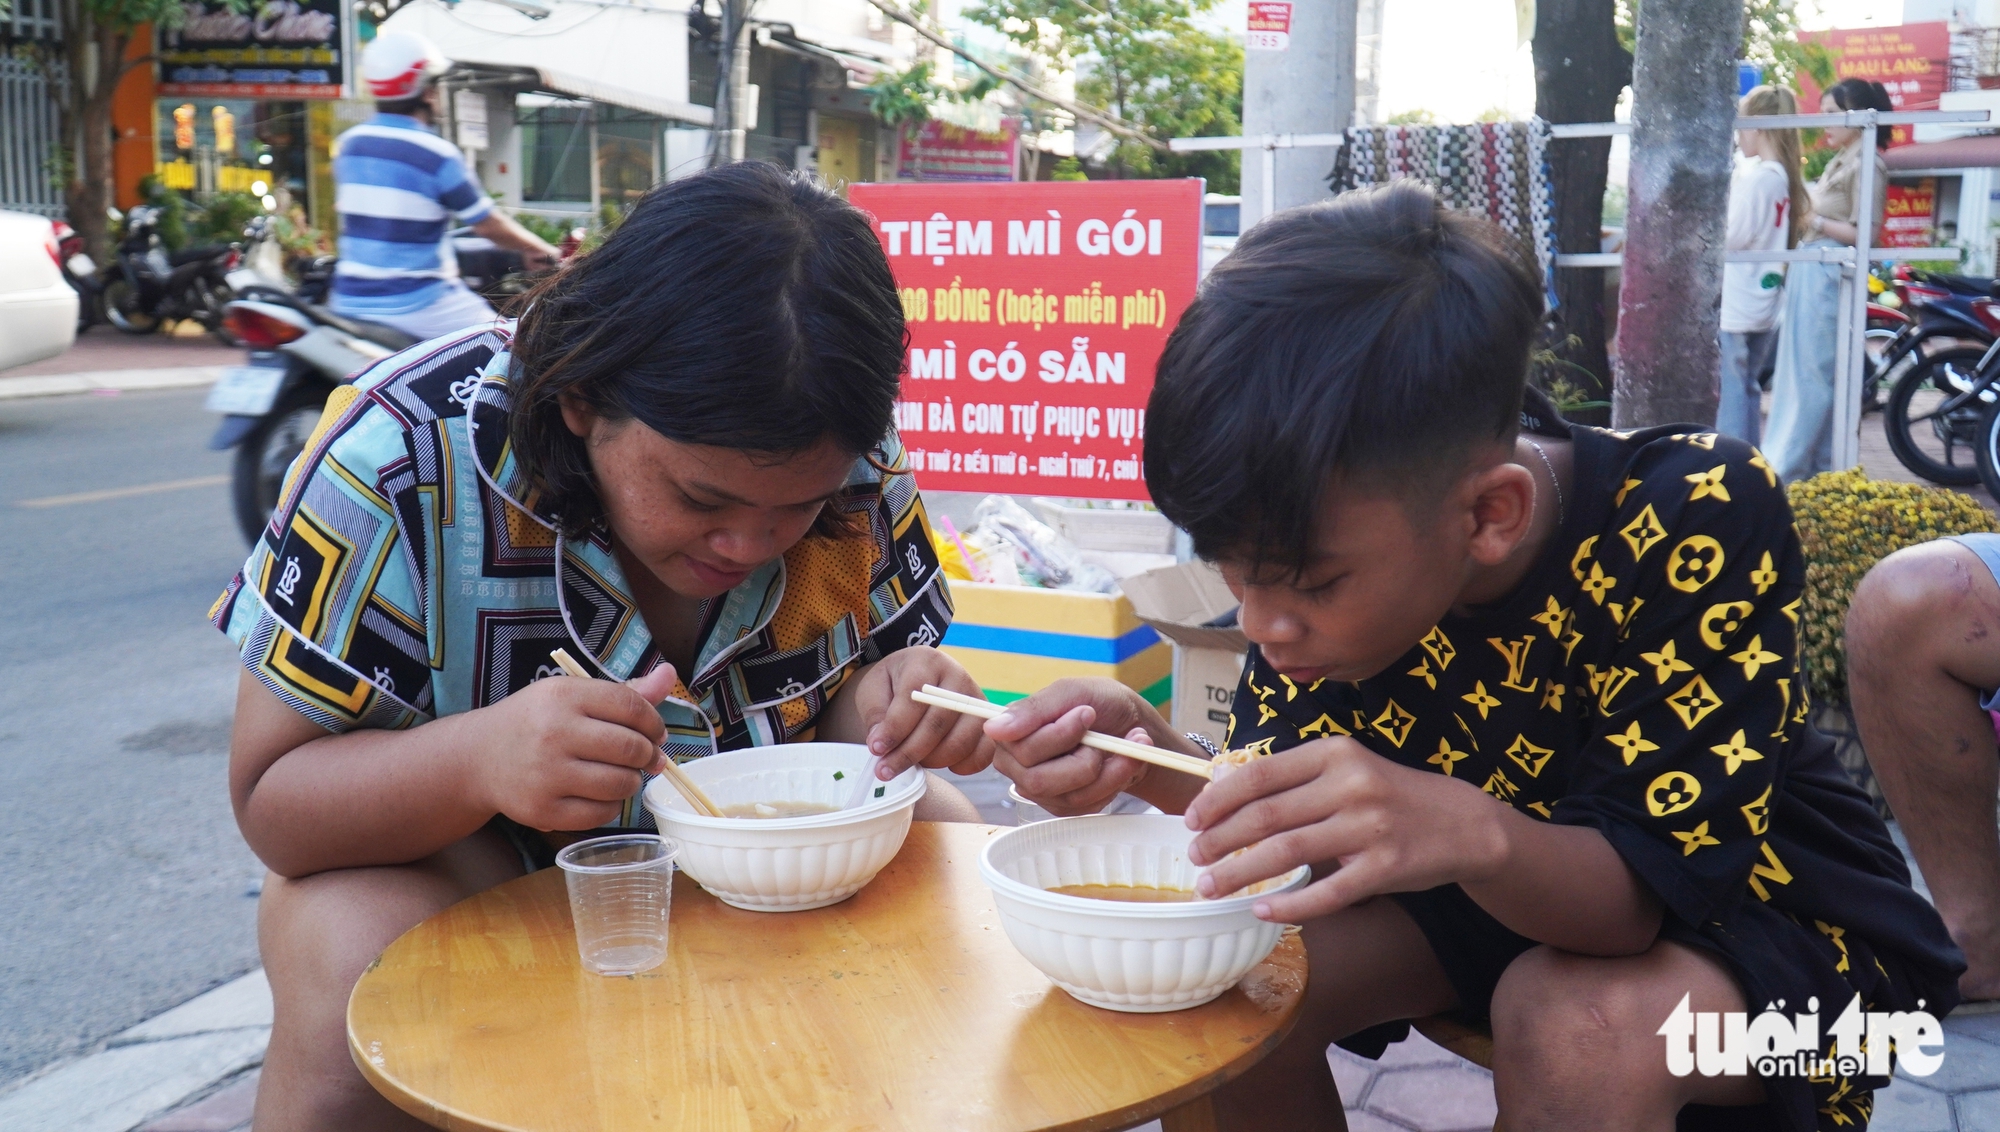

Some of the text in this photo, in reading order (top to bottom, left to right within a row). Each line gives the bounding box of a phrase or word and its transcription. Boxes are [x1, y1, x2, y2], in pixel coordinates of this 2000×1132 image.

[881, 209, 1162, 266] TIỆM MÌ GÓI
[933, 275, 991, 323] ĐỒNG
[996, 288, 1059, 332] (hoặc
[1064, 280, 1117, 324] miễn
[1122, 287, 1167, 330] phí)
[911, 336, 1126, 385] MÌ CÓ SẴN
[928, 396, 956, 433] BÀ
[962, 403, 1004, 435] CON
[1009, 401, 1040, 443] TỰ
[1044, 406, 1100, 445] PHỤC
[908, 447, 925, 472] TỪ
[927, 448, 951, 473] THỨ
[952, 453, 962, 473] 2
[963, 449, 990, 474] ĐẾN
[992, 452, 1018, 475] THỨ
[1018, 455, 1028, 476] 6
[1039, 452, 1068, 478] NGHỈ
[1096, 459, 1111, 482] 7,
[1113, 454, 1140, 481] CHỦ
